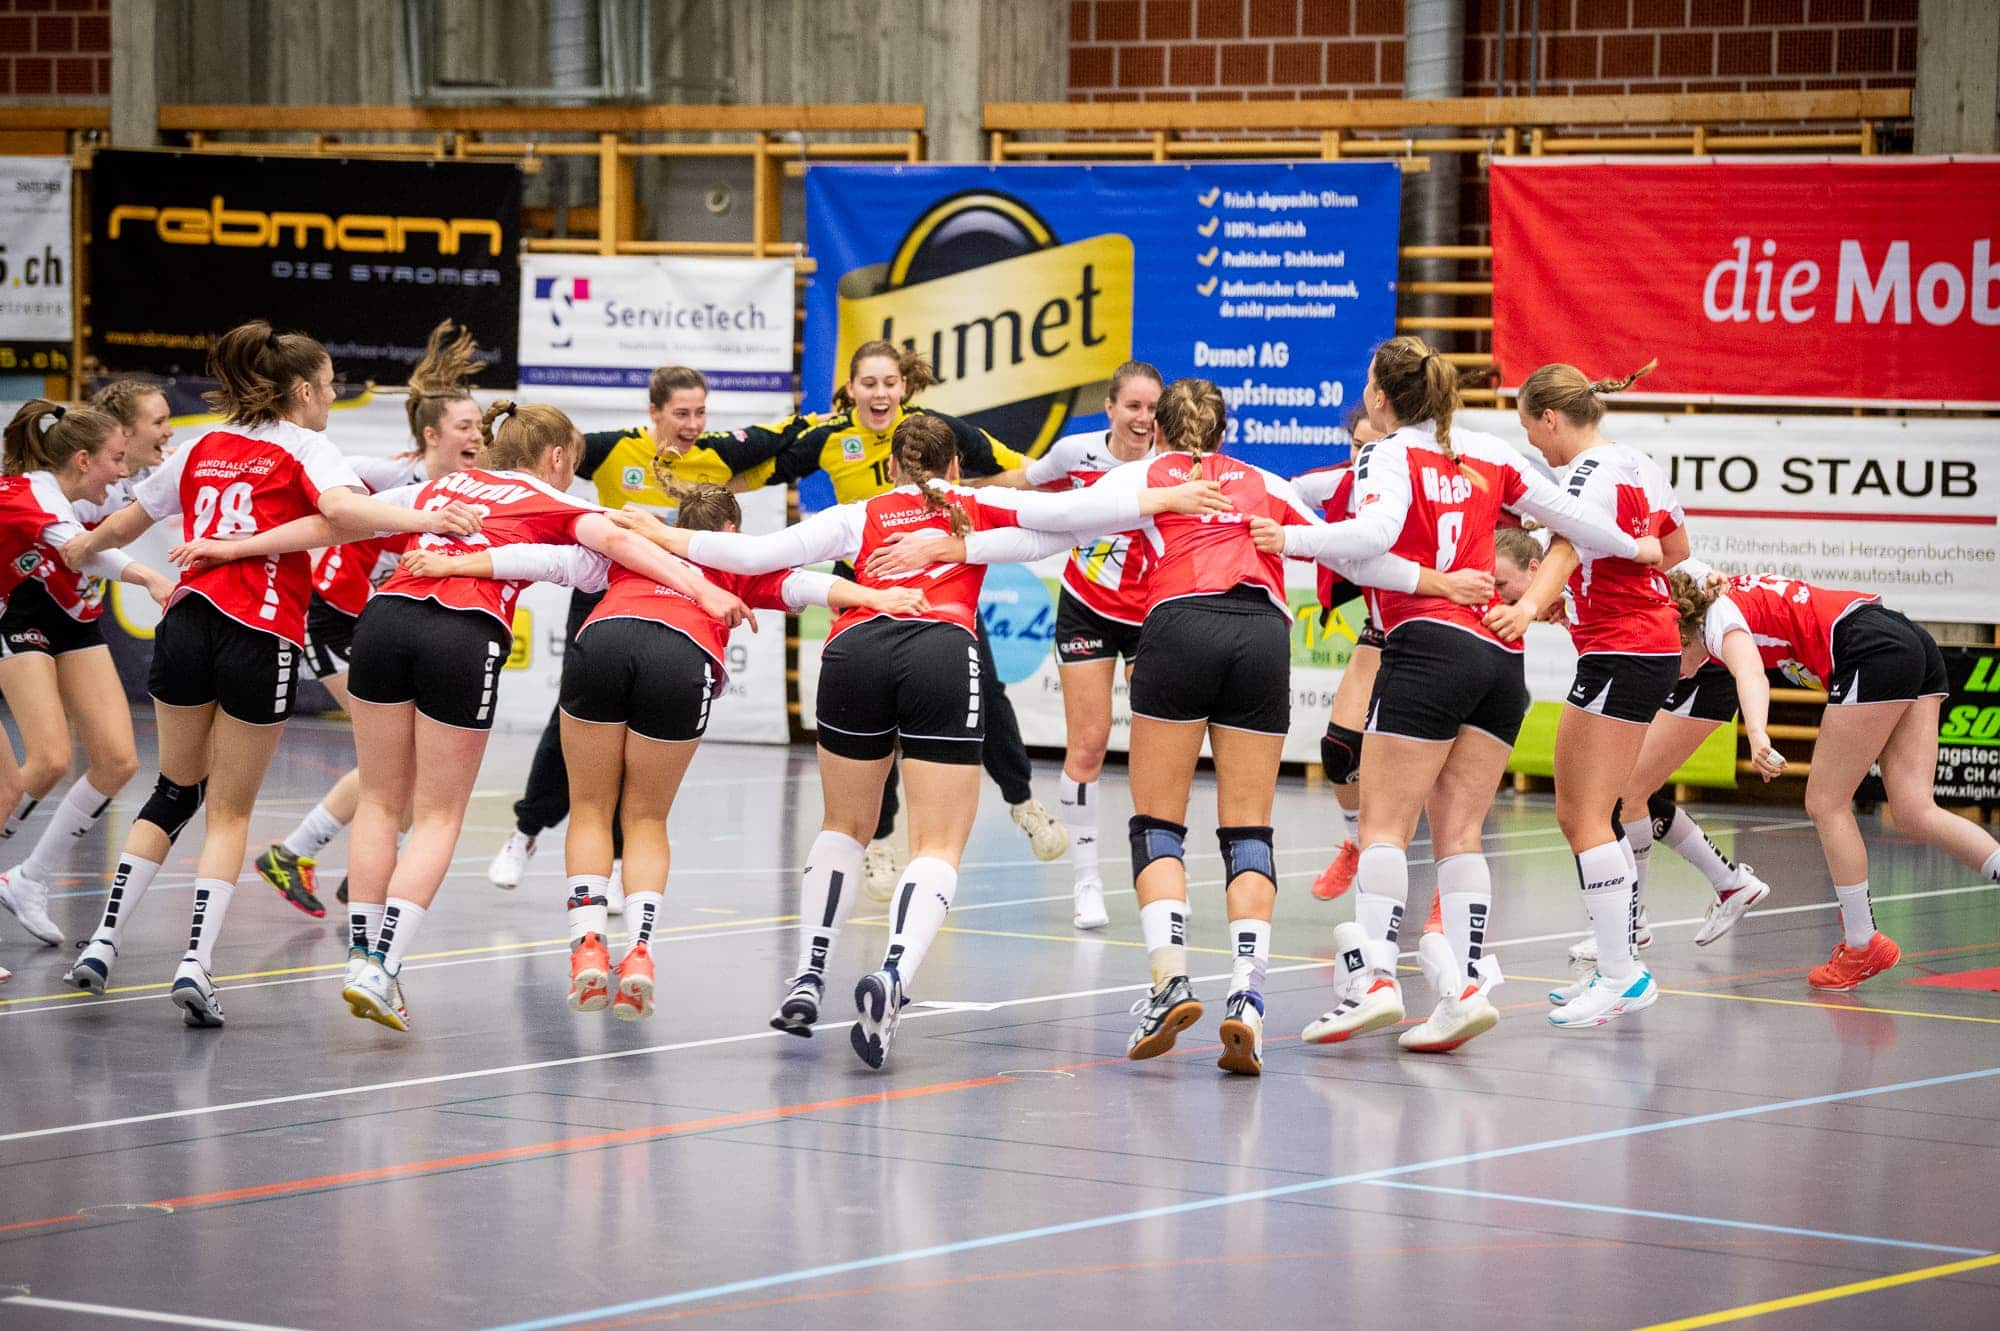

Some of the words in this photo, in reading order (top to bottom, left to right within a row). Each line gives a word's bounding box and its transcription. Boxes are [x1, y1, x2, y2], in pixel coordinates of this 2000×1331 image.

[1223, 191, 1256, 208] Frisch
[1321, 190, 1358, 207] Oliven
[108, 195, 502, 256] rebmann
[1224, 222, 1256, 238] 100%
[1222, 250, 1281, 268] Praktischer
[272, 260, 333, 279] DIE
[350, 264, 500, 286] STROMER
[1703, 237, 1820, 323] die
[1835, 239, 2000, 326] Mob
[1221, 280, 1295, 297] Authentischer
[604, 301, 767, 330] ServiceTech
[1219, 301, 1234, 318] da
[1235, 301, 1264, 318] nicht
[882, 264, 1107, 385] umet
[1194, 340, 1257, 368] Dumet
[1259, 341, 1290, 368] AG
[1318, 381, 1344, 407] 30
[1781, 458, 1978, 499] STAUB
[1821, 539, 1846, 557] bei
[1850, 540, 1997, 564] Herzogenbuchsee
[1811, 567, 1954, 585] www.autostaub.ch
[1964, 767, 1985, 782] CH
